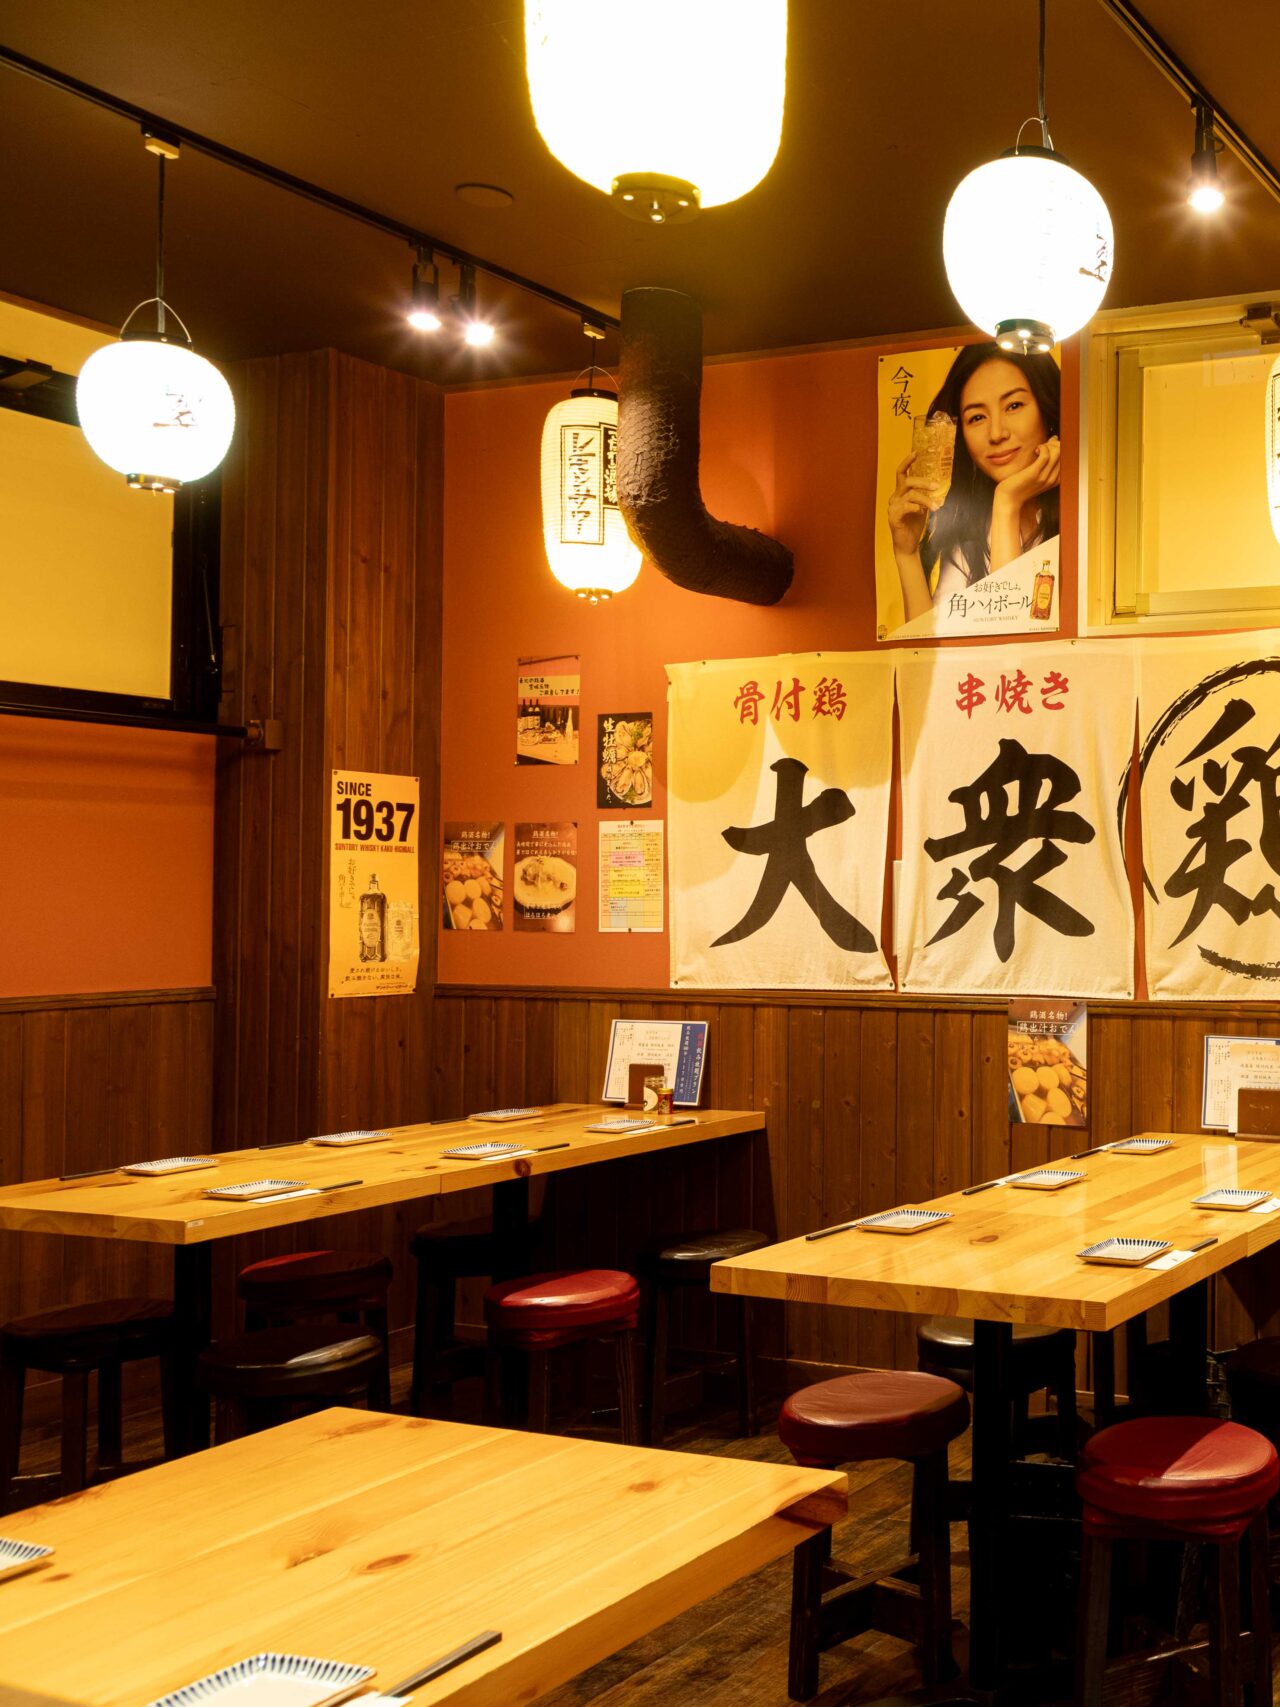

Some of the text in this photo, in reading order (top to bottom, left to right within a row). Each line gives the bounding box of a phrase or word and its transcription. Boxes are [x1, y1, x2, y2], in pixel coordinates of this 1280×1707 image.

[890, 366, 914, 421] 今夜、
[568, 432, 596, 535] レモンサワー
[947, 592, 1034, 619] 角ハイボール
[732, 678, 849, 727] 骨付鶏
[955, 668, 1071, 721] 串焼き
[336, 780, 373, 797] SINCE
[336, 798, 415, 842] 1937
[335, 843, 358, 851] SUNTORY
[360, 844, 379, 852] WHISKY
